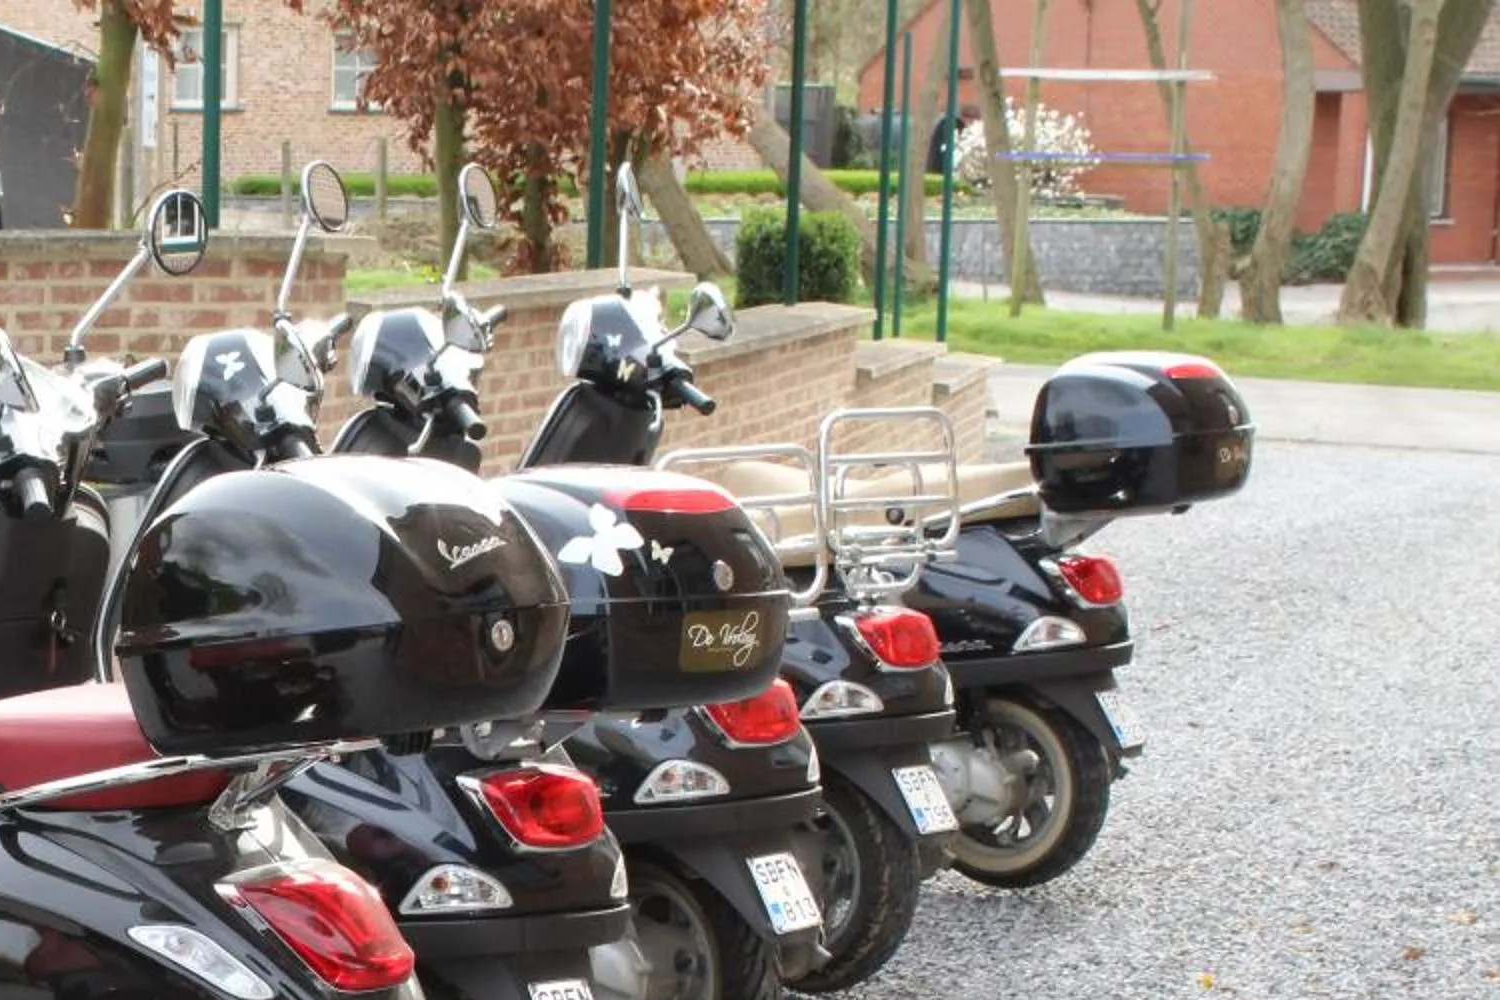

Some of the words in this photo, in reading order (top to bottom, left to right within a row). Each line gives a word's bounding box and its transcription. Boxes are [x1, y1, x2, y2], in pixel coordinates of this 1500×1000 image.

[437, 535, 508, 570] Vespa
[755, 859, 800, 885] SBFN
[783, 897, 817, 922] 813
